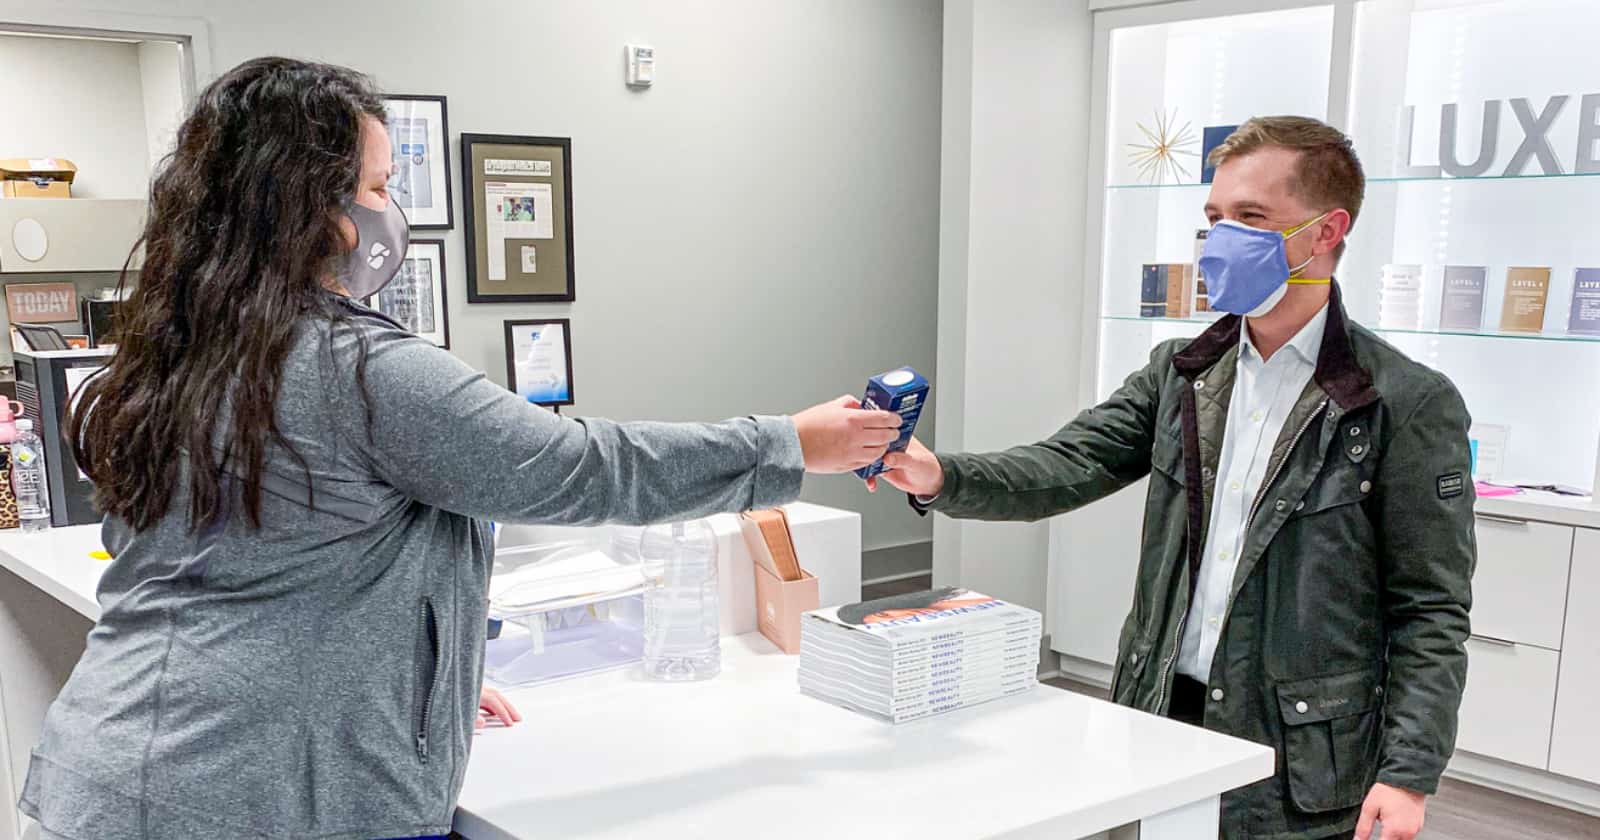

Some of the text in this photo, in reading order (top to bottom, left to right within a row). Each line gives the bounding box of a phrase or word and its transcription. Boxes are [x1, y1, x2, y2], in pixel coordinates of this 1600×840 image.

[1397, 93, 1600, 178] LUXE
[1512, 279, 1537, 287] LEVEL
[11, 290, 70, 314] TODAY
